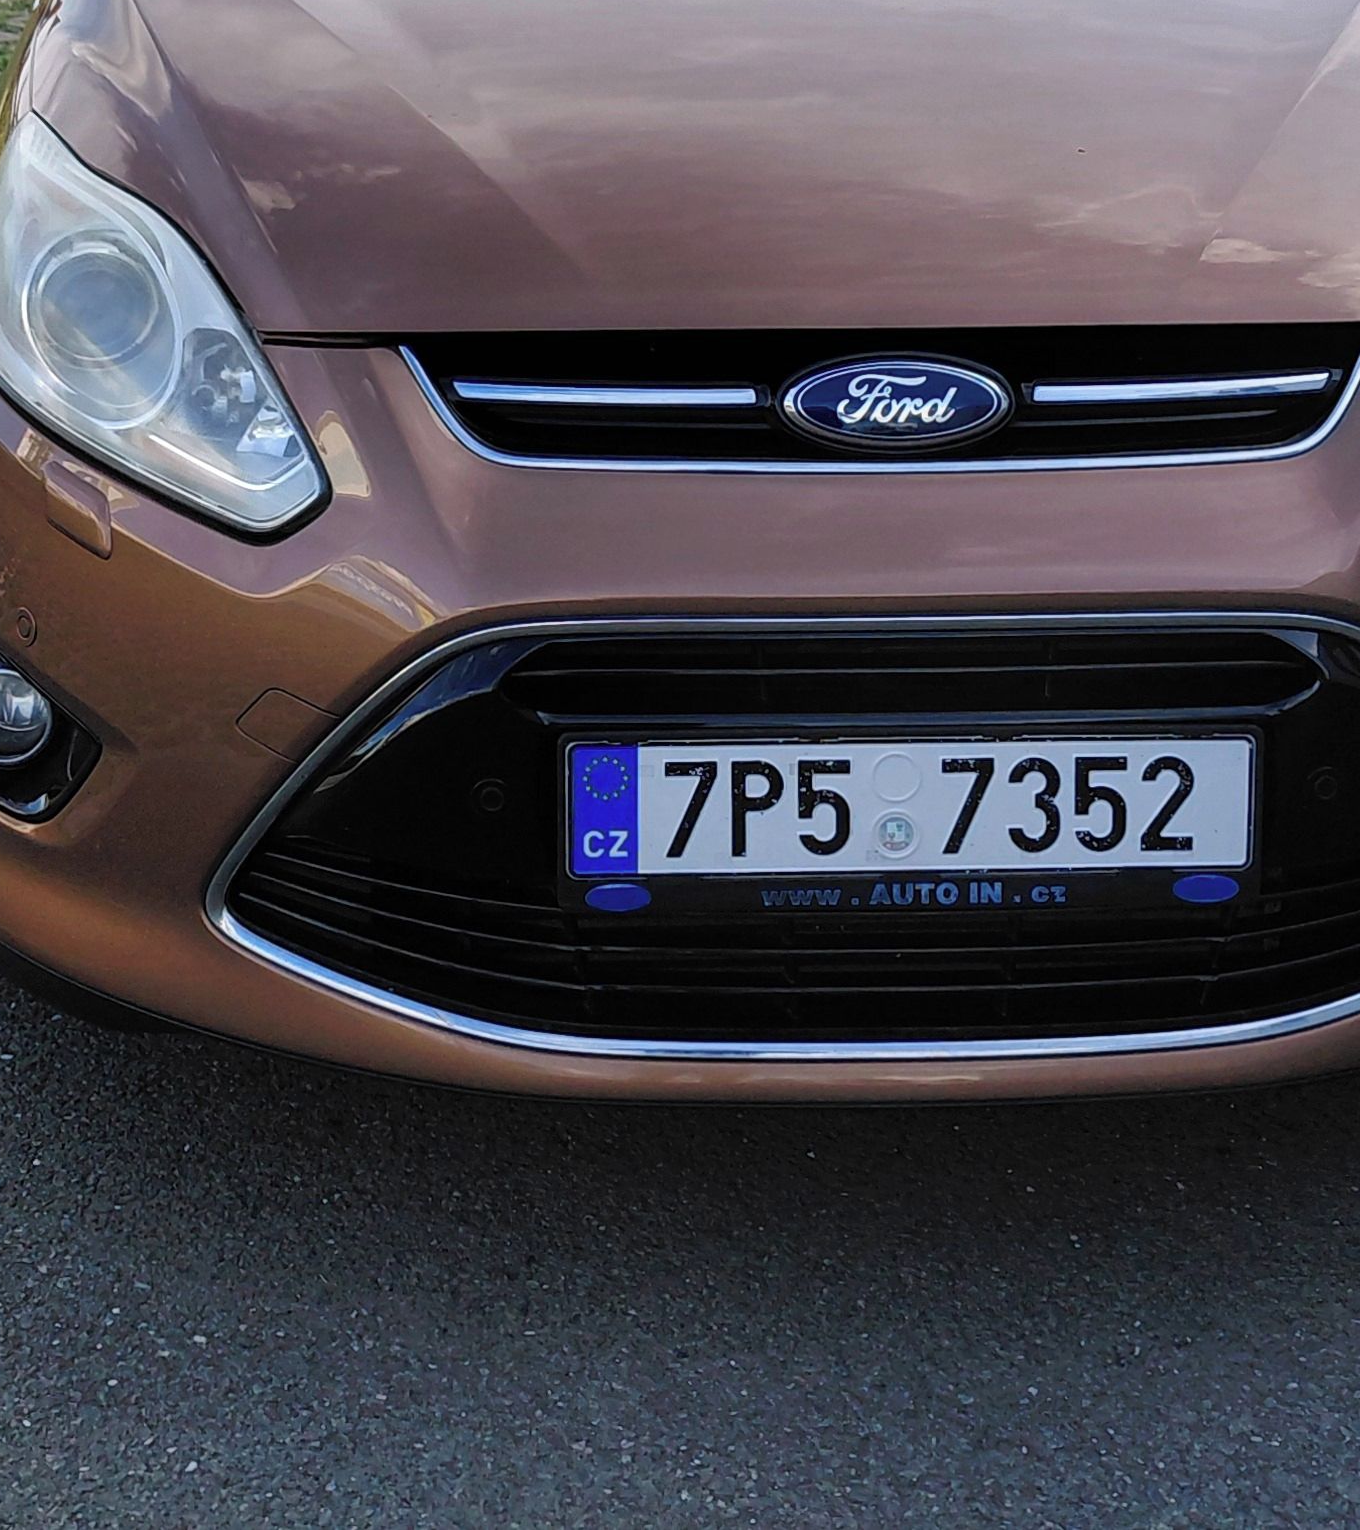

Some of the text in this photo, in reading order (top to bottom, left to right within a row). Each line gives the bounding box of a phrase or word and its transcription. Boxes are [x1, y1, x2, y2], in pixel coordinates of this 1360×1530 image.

[837, 374, 958, 424] Ford
[663, 755, 1196, 859] 7P5 7352
[582, 830, 629, 860] CZ
